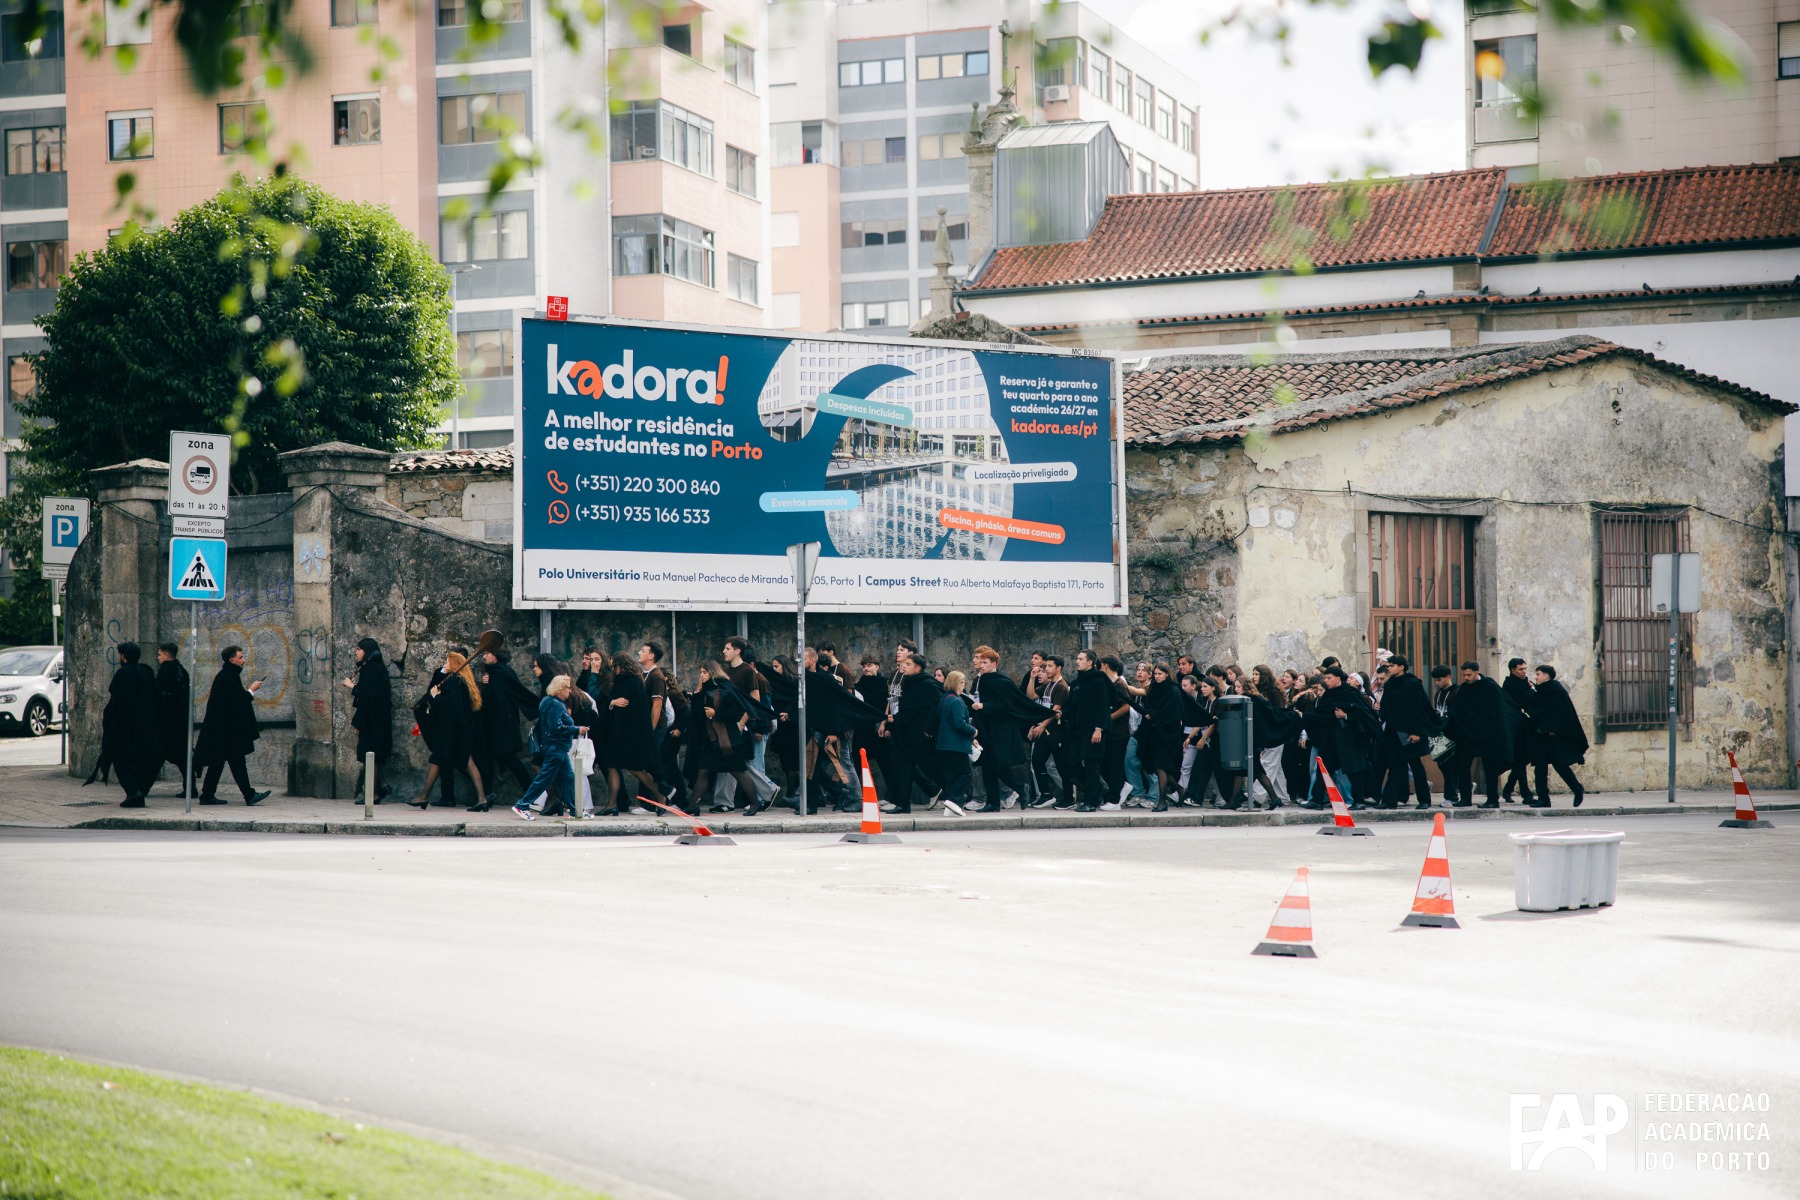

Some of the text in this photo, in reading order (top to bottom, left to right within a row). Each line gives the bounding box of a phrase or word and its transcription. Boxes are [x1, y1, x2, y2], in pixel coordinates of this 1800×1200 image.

[547, 344, 729, 406] kadora!
[1000, 376, 1036, 388] Reserva
[1036, 377, 1047, 389] já
[1055, 379, 1090, 391] garante
[1003, 390, 1017, 400] teu
[1019, 391, 1049, 403] quarto
[1051, 393, 1072, 404] para
[827, 399, 867, 415] Despesas
[1011, 404, 1098, 416] académico 26/27 en
[545, 409, 734, 437] A melhor residência
[1011, 419, 1098, 439] kadora.es/pt
[188, 440, 214, 450] zona
[545, 431, 762, 460] de estudantes no Porto
[974, 468, 1069, 480] Localização priveligiada
[575, 474, 720, 495] (+351) 220 300 840
[56, 504, 75, 512] zona
[771, 497, 848, 508] Eventos semanais
[575, 504, 710, 524] (+351) 935 166 533
[943, 512, 1061, 540] Piscina, ginásio, áreas comuns
[539, 568, 564, 579] Polo
[566, 568, 640, 581] Universitário
[643, 572, 661, 581] Rua
[663, 572, 696, 582] Manuel
[699, 572, 737, 583] Pacheco
[738, 573, 750, 583] de
[752, 574, 788, 584] Miranda
[830, 576, 854, 586] Porto
[865, 575, 906, 589] Campus
[910, 575, 941, 588] Street
[943, 578, 959, 588] Rua
[960, 578, 990, 589] Alberto
[992, 578, 1030, 591] Malafaya
[1032, 579, 1066, 591] Baptista
[1067, 580, 1080, 590] 171,
[1082, 580, 1104, 590] Porto
